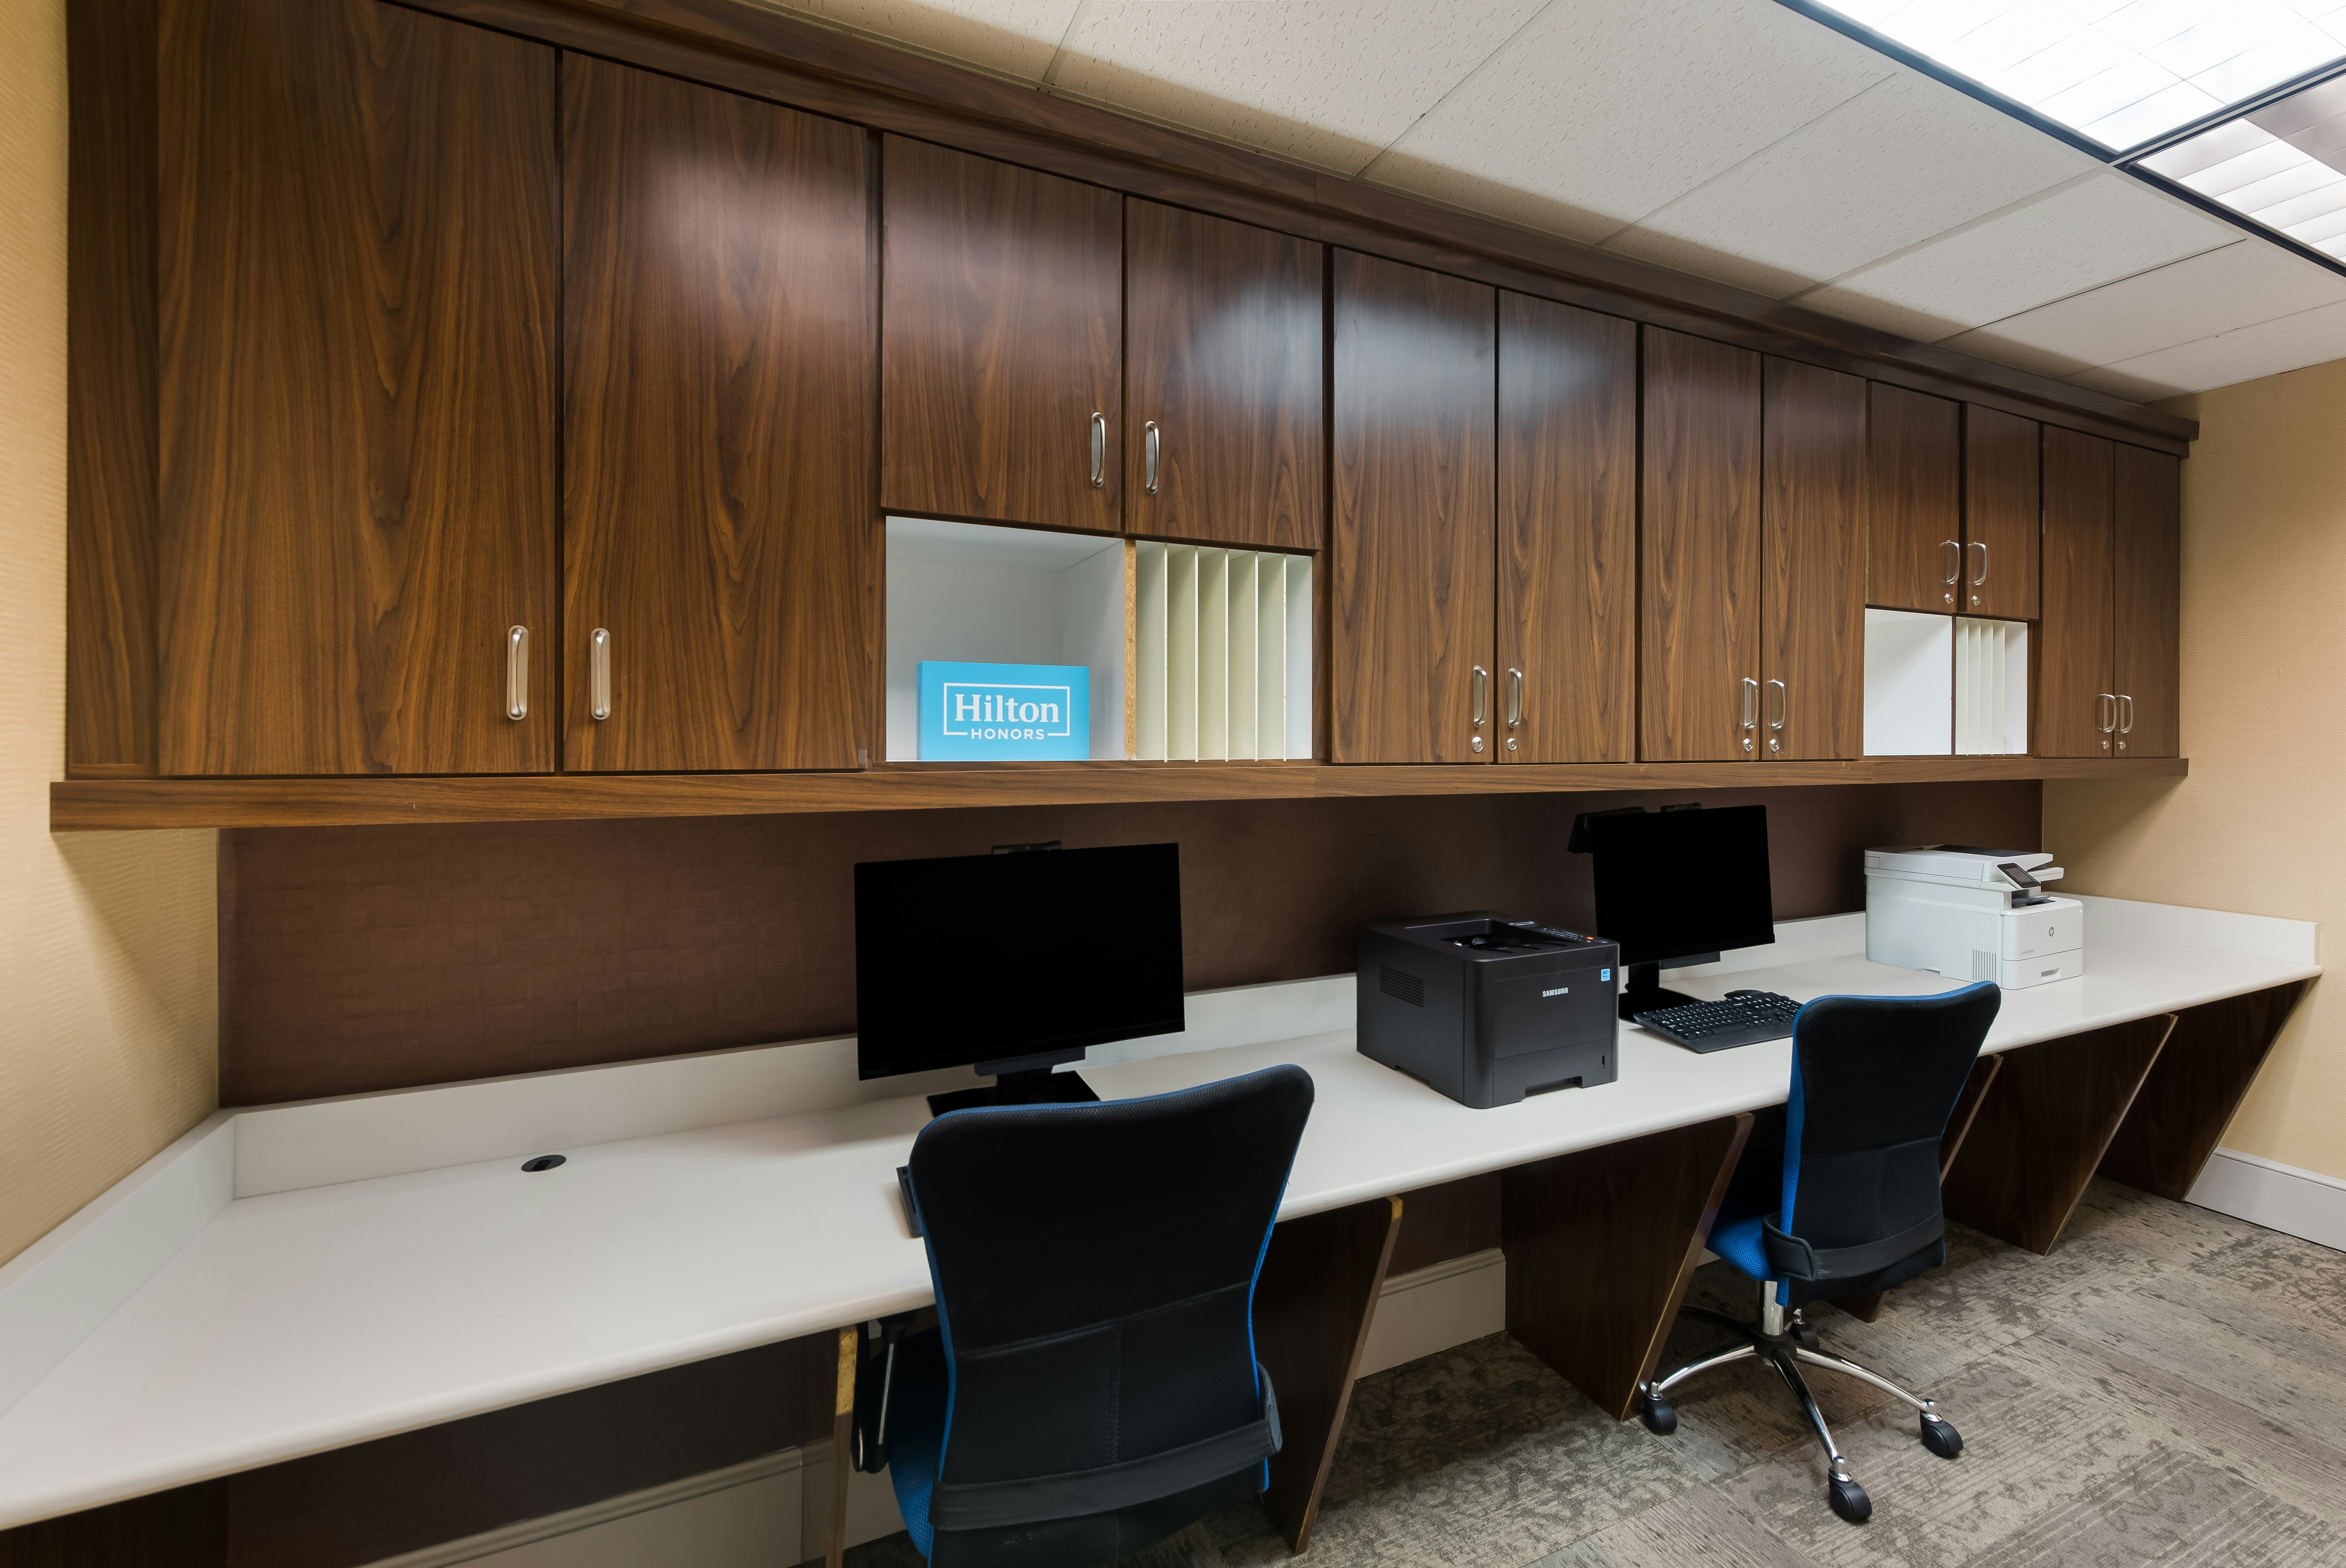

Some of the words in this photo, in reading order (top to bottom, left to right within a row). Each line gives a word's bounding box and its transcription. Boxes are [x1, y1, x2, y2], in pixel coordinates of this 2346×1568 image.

[955, 694, 1060, 722] Hilton
[971, 728, 1044, 740] HONORS
[1542, 987, 1568, 997] SAMSUNG
